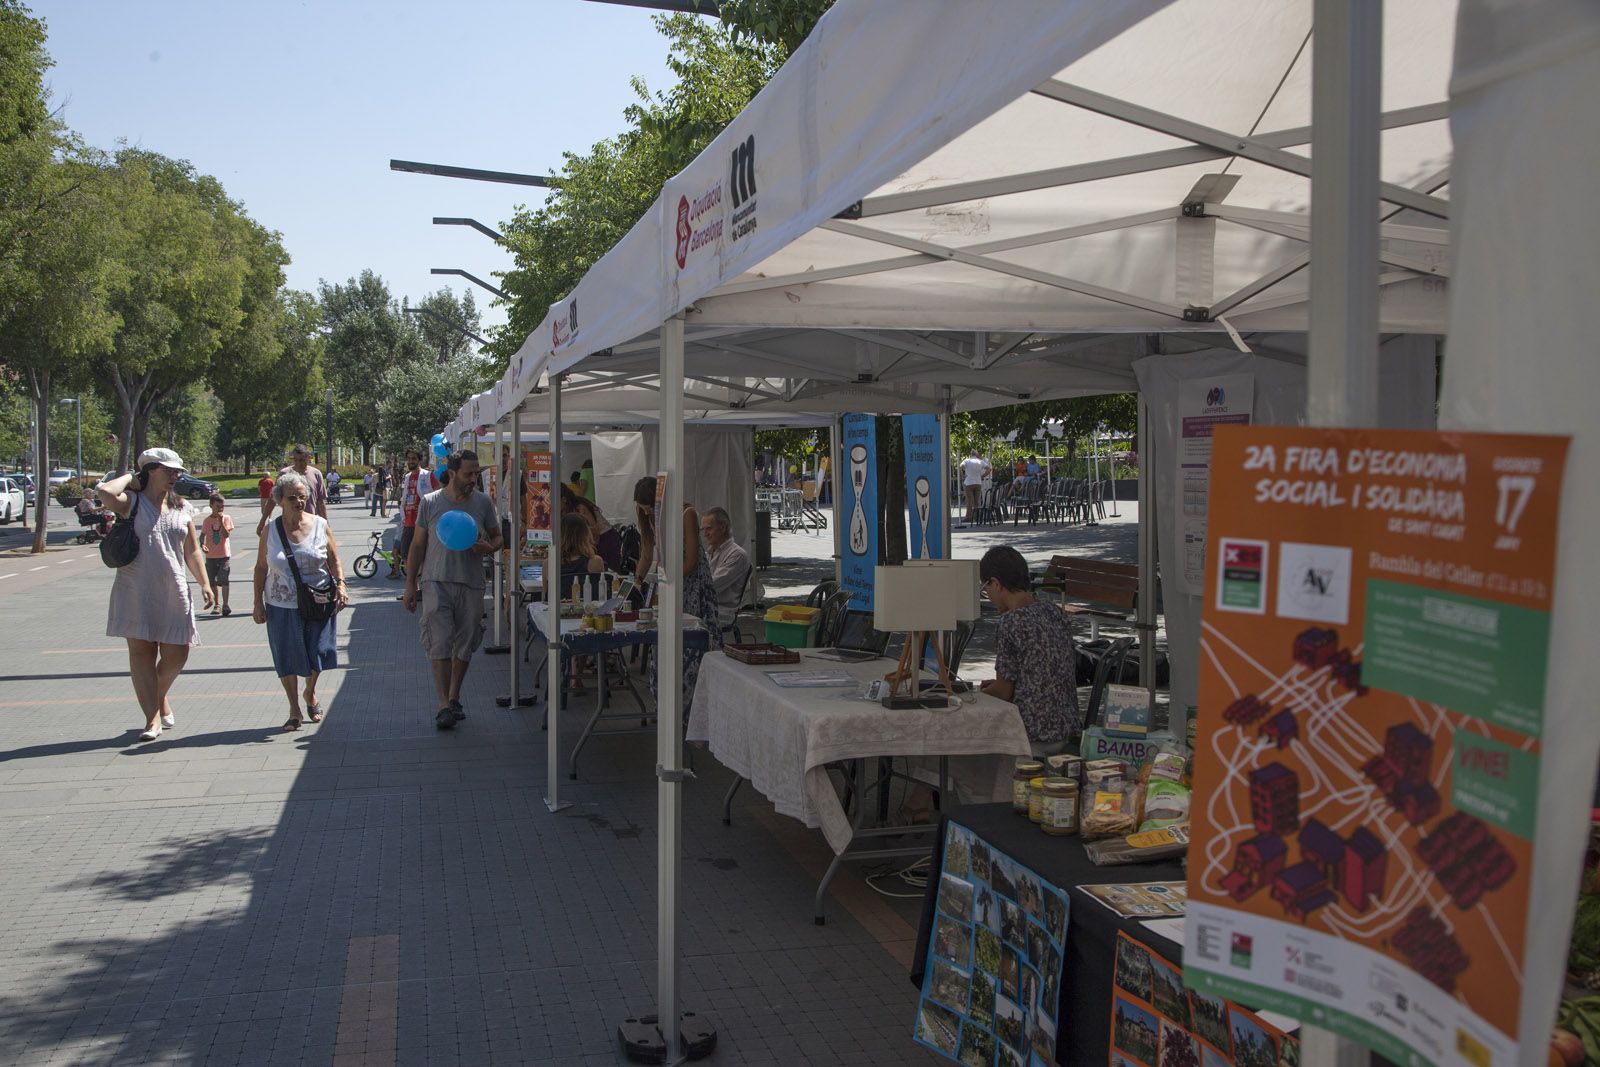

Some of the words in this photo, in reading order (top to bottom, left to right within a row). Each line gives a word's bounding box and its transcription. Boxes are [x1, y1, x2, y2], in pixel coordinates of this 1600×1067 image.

[690, 181, 722, 223] Diputació
[690, 218, 723, 252] Barcelona
[1243, 445, 1276, 472] 2A
[1284, 447, 1339, 477] FIRA
[1347, 449, 1467, 483] D'ECONOMIA
[1255, 478, 1346, 508] SOCIAL
[1352, 485, 1360, 509] I
[1366, 482, 1466, 522] SOLIDÀRIA
[1494, 475, 1537, 534] 17
[1368, 552, 1422, 577] Rambla
